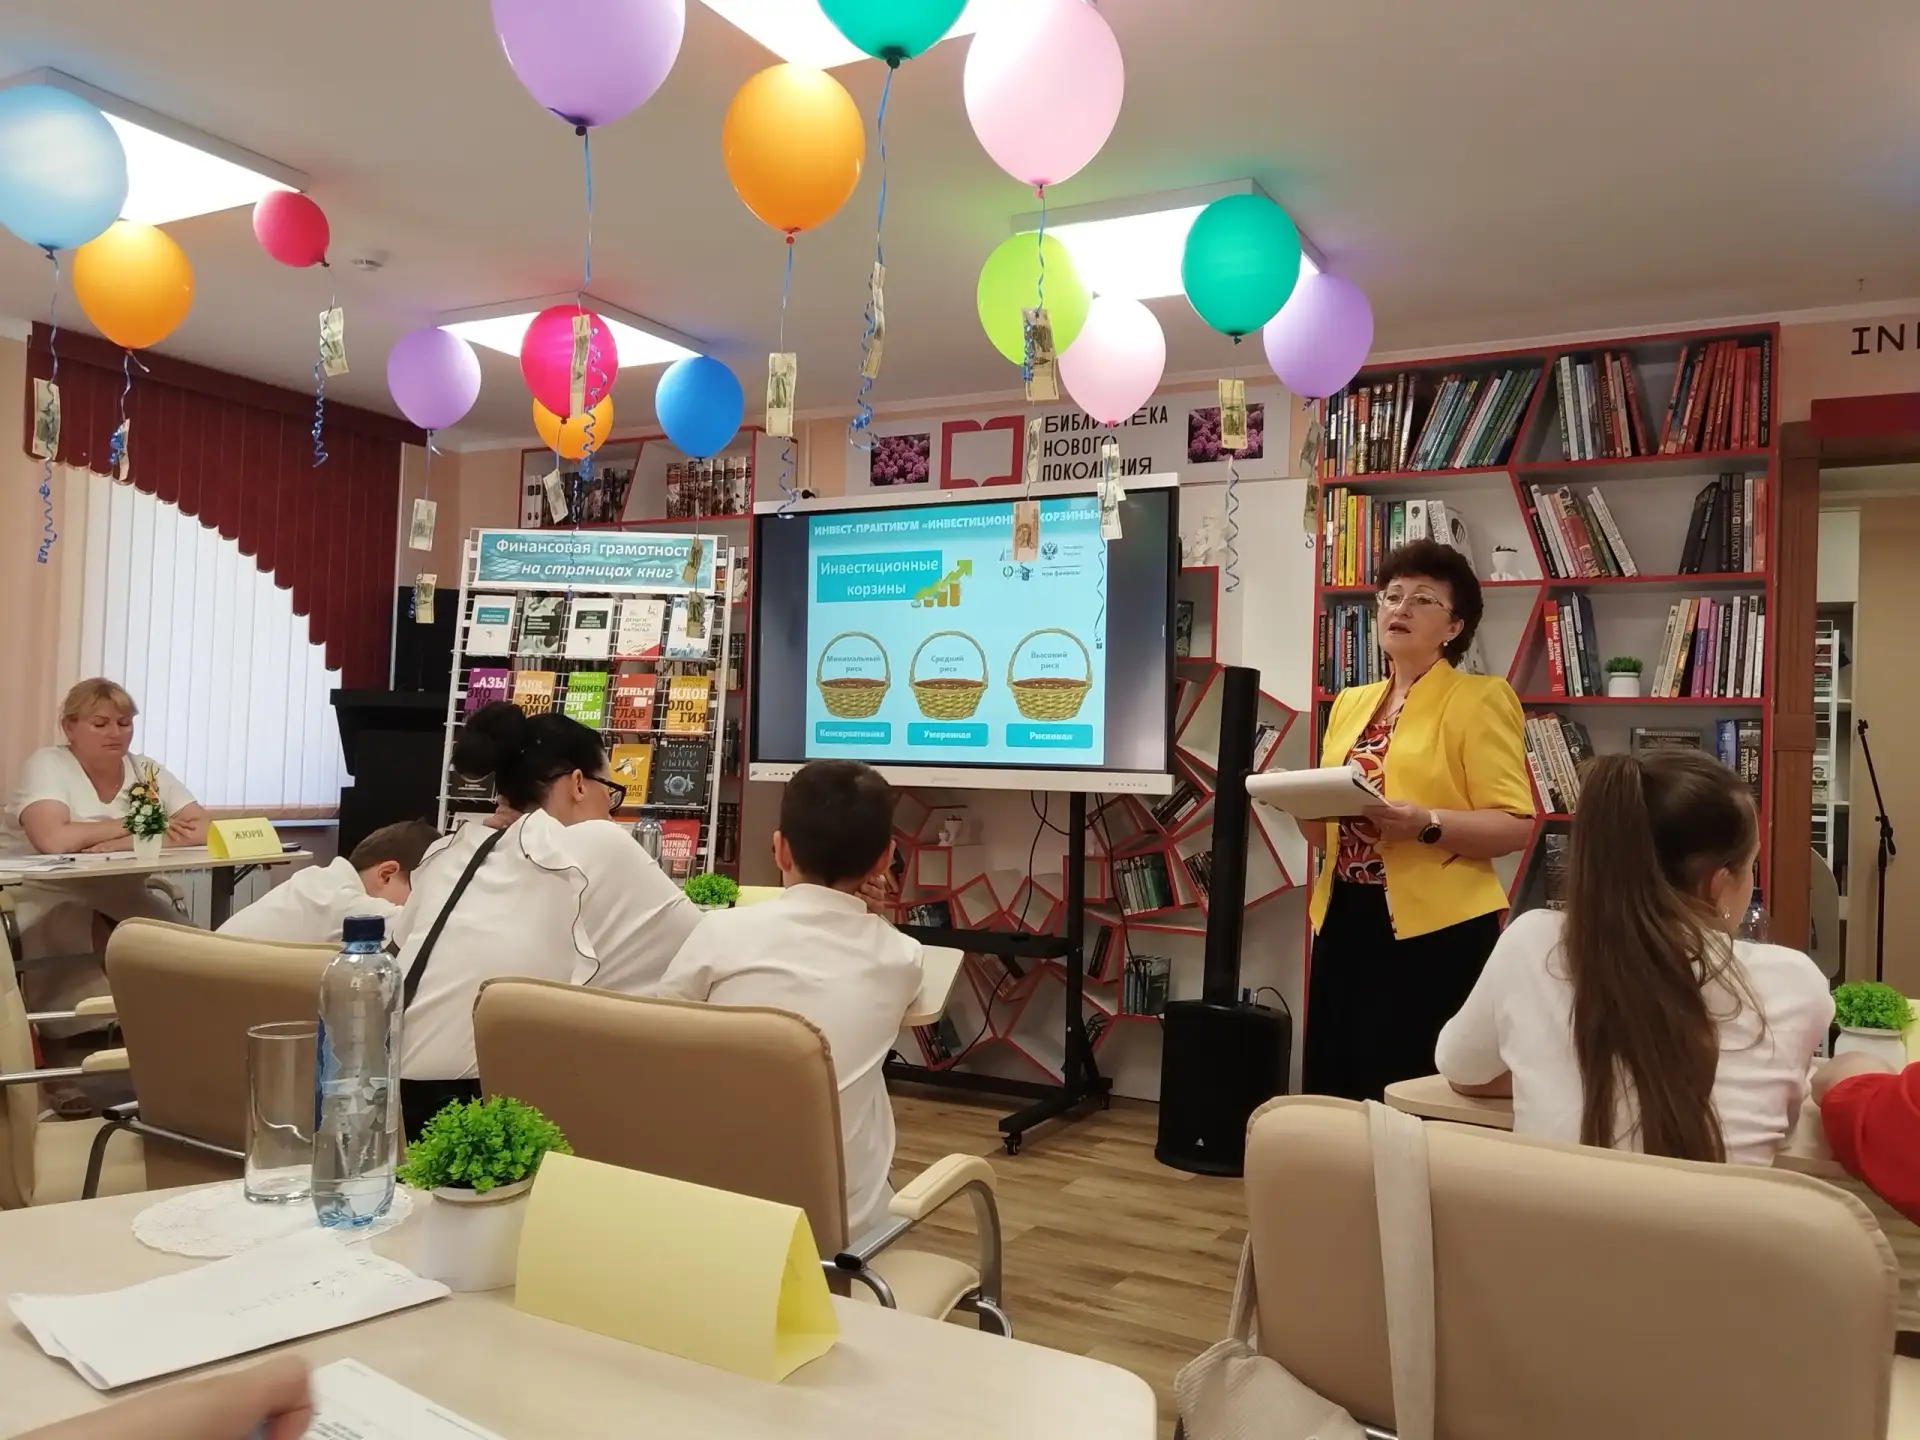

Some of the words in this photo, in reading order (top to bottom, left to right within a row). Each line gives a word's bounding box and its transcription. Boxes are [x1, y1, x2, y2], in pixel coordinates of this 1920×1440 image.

[1045, 406, 1168, 433] БИБЛЕКА
[1043, 457, 1152, 481] ПОКОЛНИЯ
[814, 521, 919, 535] ИНВЕСТ-ПРАКТИКУМ
[922, 515, 1013, 531] «ИНВЕСТИЦИОН
[496, 538, 591, 555] Финансовая
[599, 543, 691, 559] грамотност
[522, 561, 540, 575] на
[544, 562, 632, 578] страницах
[636, 567, 674, 579] книг
[821, 557, 939, 576] Инвестиционные
[846, 582, 907, 598] корзины
[1552, 621, 1560, 640] РУКИ
[826, 654, 881, 663] Минимальный
[930, 654, 964, 664] Средний
[1030, 651, 1068, 660] Высокий
[1553, 642, 1563, 675] ЗОЛОТЫЕ
[845, 666, 863, 674] риск
[939, 666, 957, 675] риск
[1040, 662, 1060, 670] риск
[479, 677, 507, 688] АЗЫ
[467, 688, 491, 698] ЭКО
[565, 693, 593, 701] ИНВЕ
[616, 687, 655, 697] ДЕНЬГИ
[669, 688, 708, 700] ЖЛОБ
[525, 694, 550, 704] ЭКО
[615, 697, 631, 706] НЕ
[521, 705, 549, 715] ОМИ
[668, 700, 693, 710] ОЛО
[577, 710, 601, 720] ЦИЙ
[613, 709, 646, 718] ГЛАВ
[679, 712, 705, 723] ГИЯ
[612, 719, 637, 728] НОЕ
[923, 730, 972, 740] Умеренная
[1029, 731, 1074, 742] Рисковая
[662, 759, 700, 768] РЫНКА
[233, 830, 265, 840] ЖЮРИ
